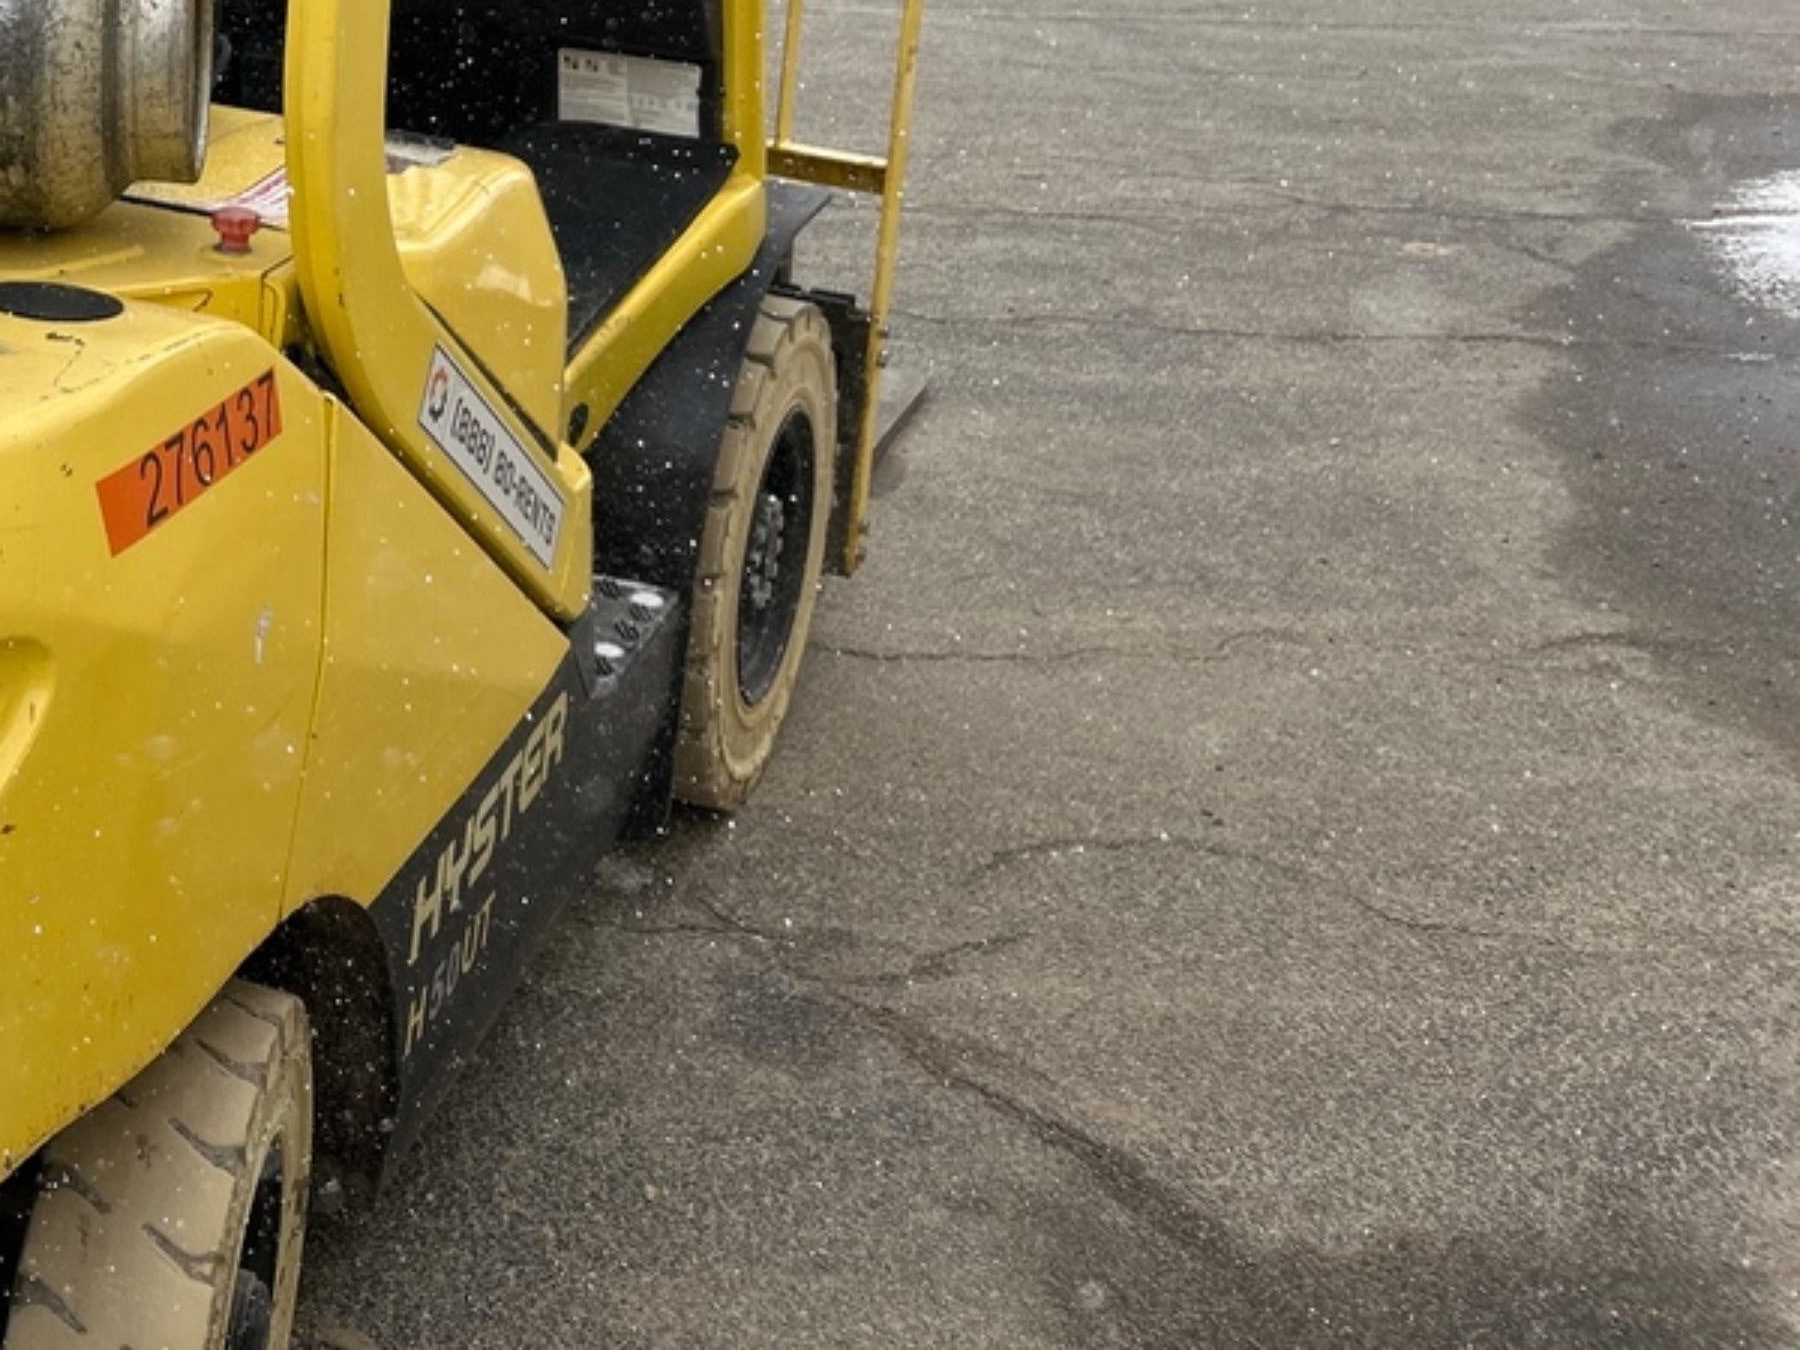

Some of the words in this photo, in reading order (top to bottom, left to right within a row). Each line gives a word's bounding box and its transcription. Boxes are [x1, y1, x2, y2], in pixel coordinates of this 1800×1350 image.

[138, 376, 277, 527] 276137
[450, 398, 496, 475] (888)
[407, 690, 569, 966] HYSTER
